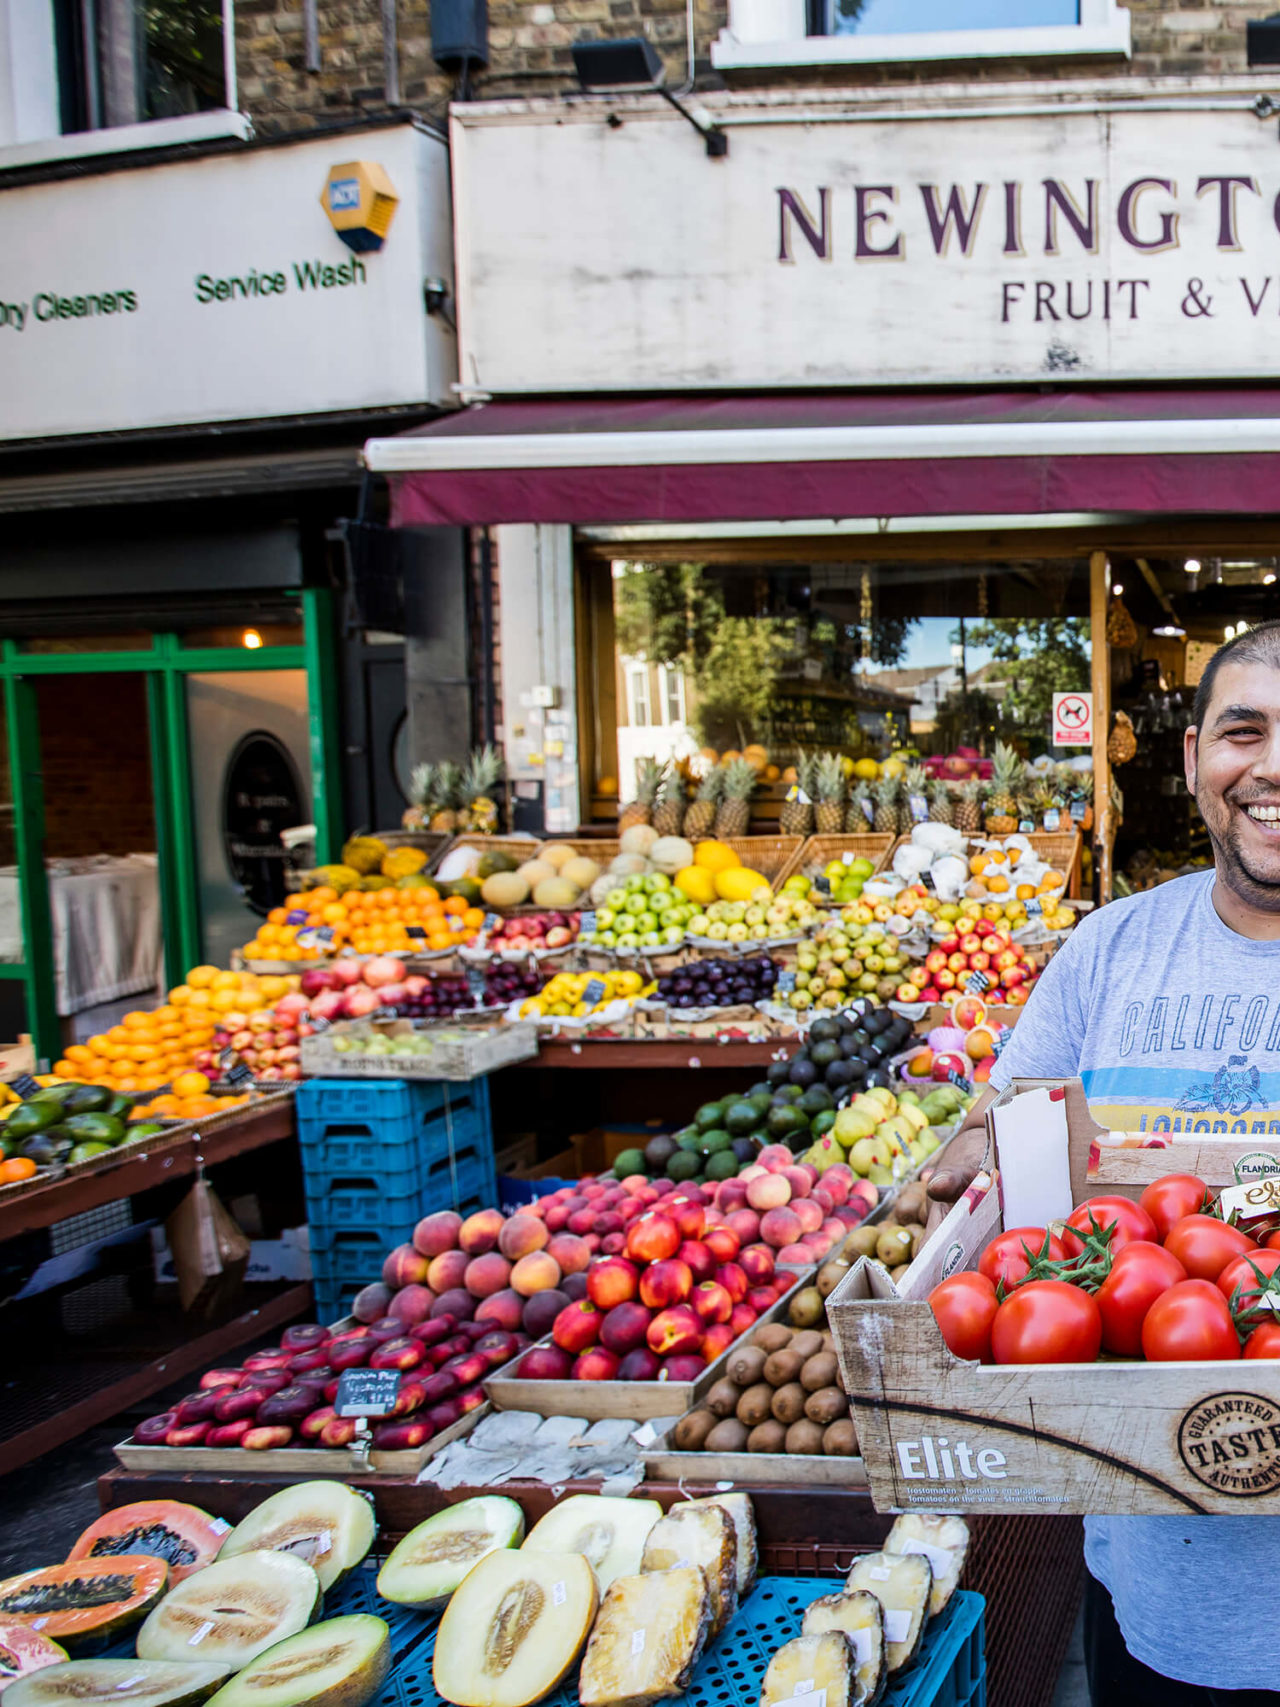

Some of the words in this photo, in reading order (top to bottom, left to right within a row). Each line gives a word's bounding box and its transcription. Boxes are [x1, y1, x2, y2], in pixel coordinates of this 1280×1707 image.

[194, 269, 288, 304] Service
[292, 254, 368, 292] Wash
[1001, 279, 1150, 322] FRUIT
[1181, 277, 1216, 318] &
[33, 288, 139, 323] Cleaners
[1188, 1399, 1274, 1440] GUARANTEED
[896, 1436, 1008, 1480] Elite
